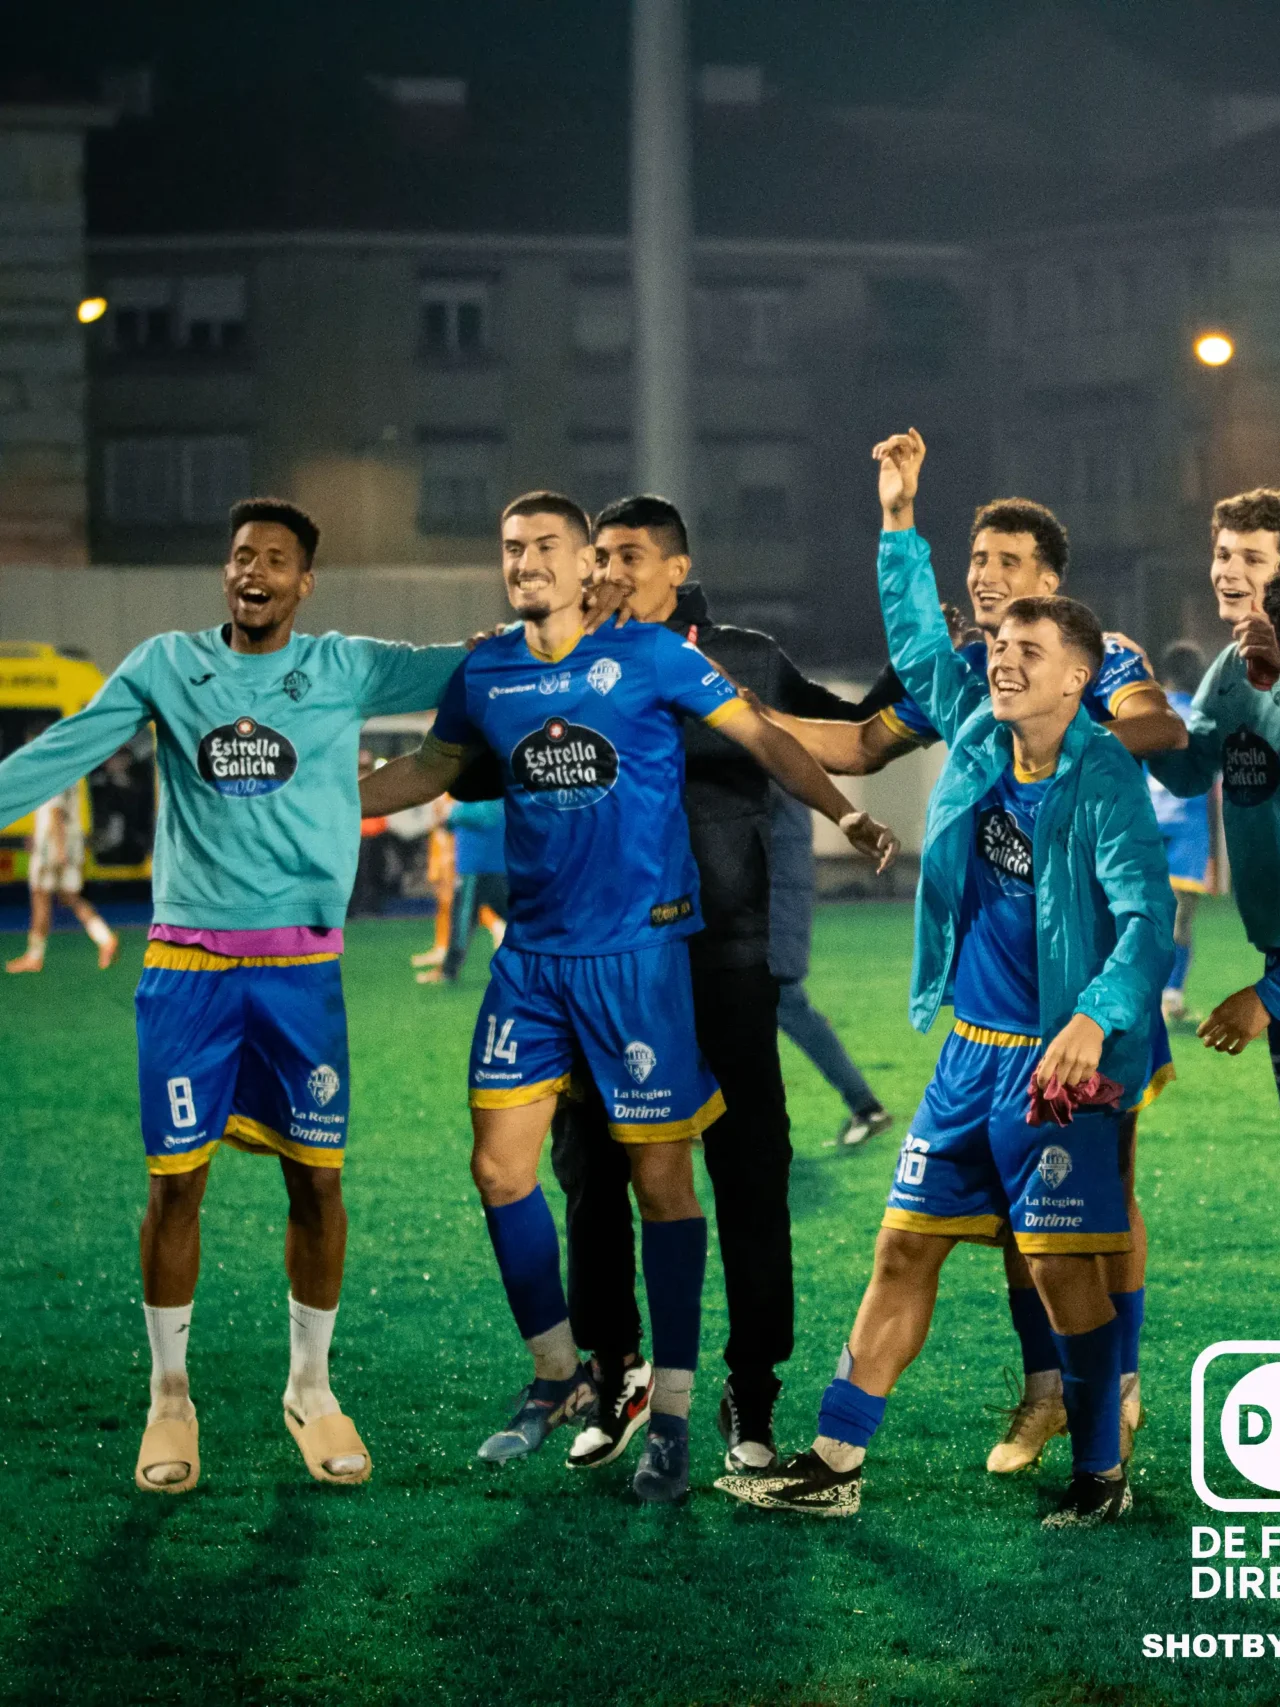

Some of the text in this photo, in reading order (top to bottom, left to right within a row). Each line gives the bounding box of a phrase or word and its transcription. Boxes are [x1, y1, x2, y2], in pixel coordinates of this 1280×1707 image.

[210, 737, 280, 758] Estrella
[524, 741, 598, 769] Estrella
[212, 757, 276, 777] Galicia
[483, 1014, 518, 1065] 14
[167, 1076, 197, 1129] 8
[613, 1088, 629, 1099] La
[1025, 1196, 1040, 1206] La
[1024, 1212, 1082, 1228] Ontime
